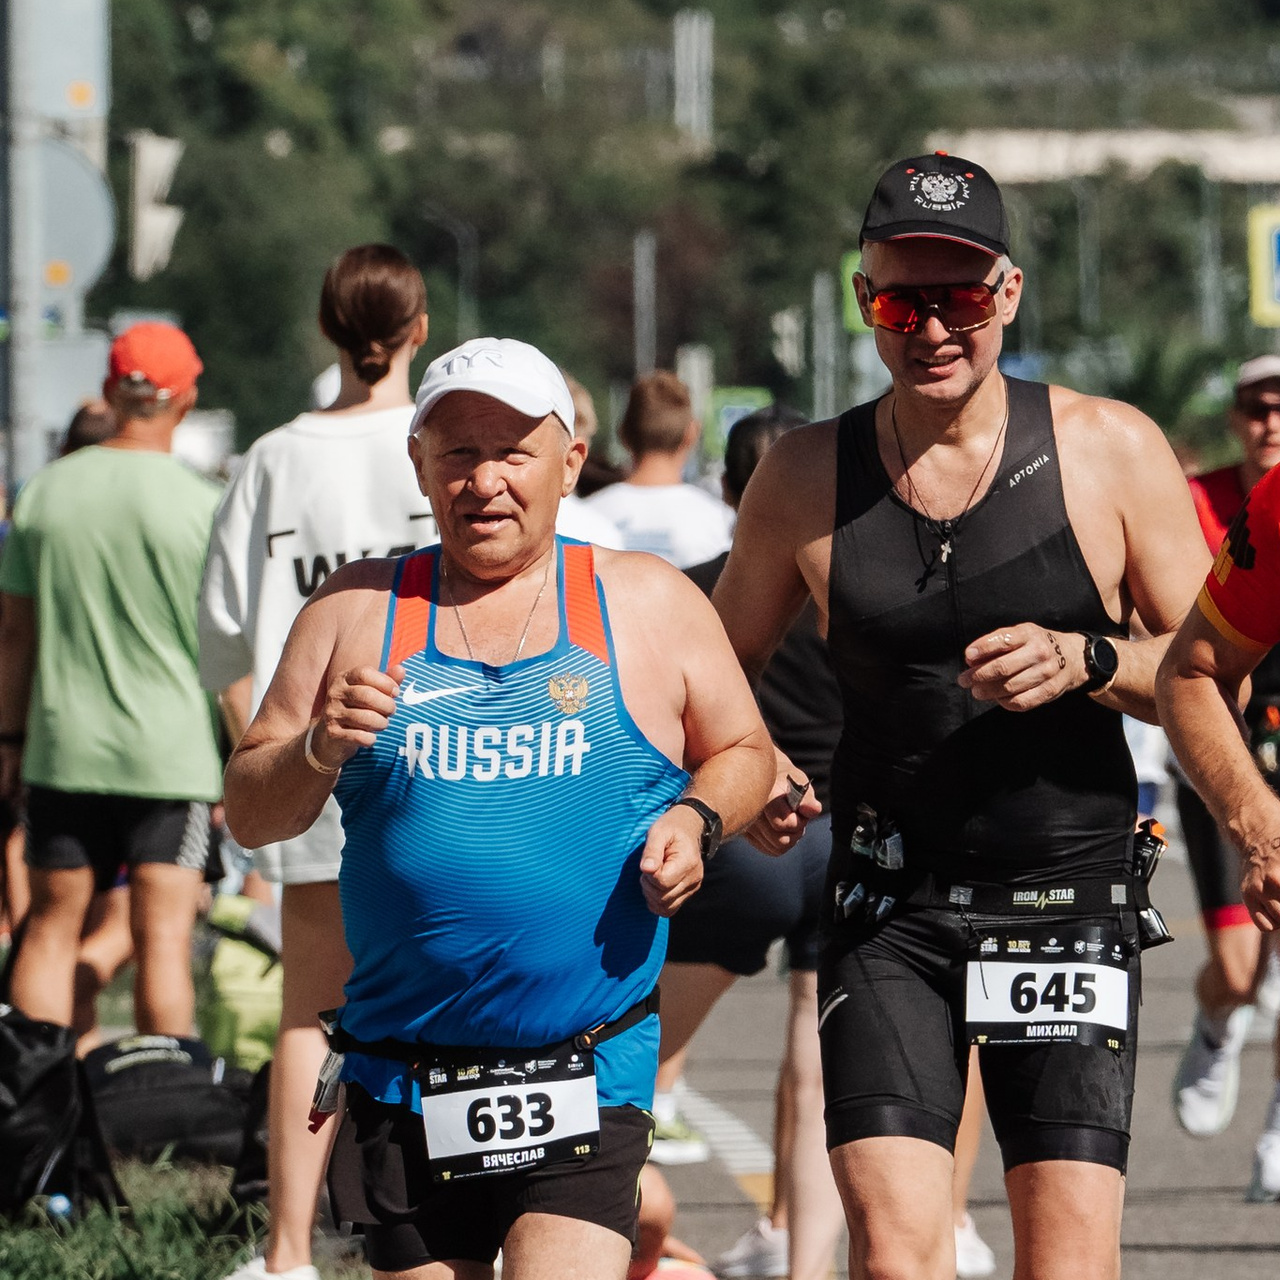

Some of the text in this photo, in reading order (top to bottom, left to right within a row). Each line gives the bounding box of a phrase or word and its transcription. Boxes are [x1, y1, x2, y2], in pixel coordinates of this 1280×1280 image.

[914, 195, 966, 211] RUSSIA
[1009, 454, 1050, 488] APTONIA
[399, 719, 591, 782] RUSSIA
[1013, 888, 1075, 902] IRON STAR
[1010, 972, 1097, 1014] 645
[1026, 1024, 1078, 1037] МИХАИЛ
[1107, 1038, 1119, 1049] 113
[429, 1073, 448, 1085] STAR
[467, 1092, 555, 1143] 633
[482, 1147, 546, 1168] ВЯЧЕСЛАВ
[574, 1145, 591, 1155] 113
